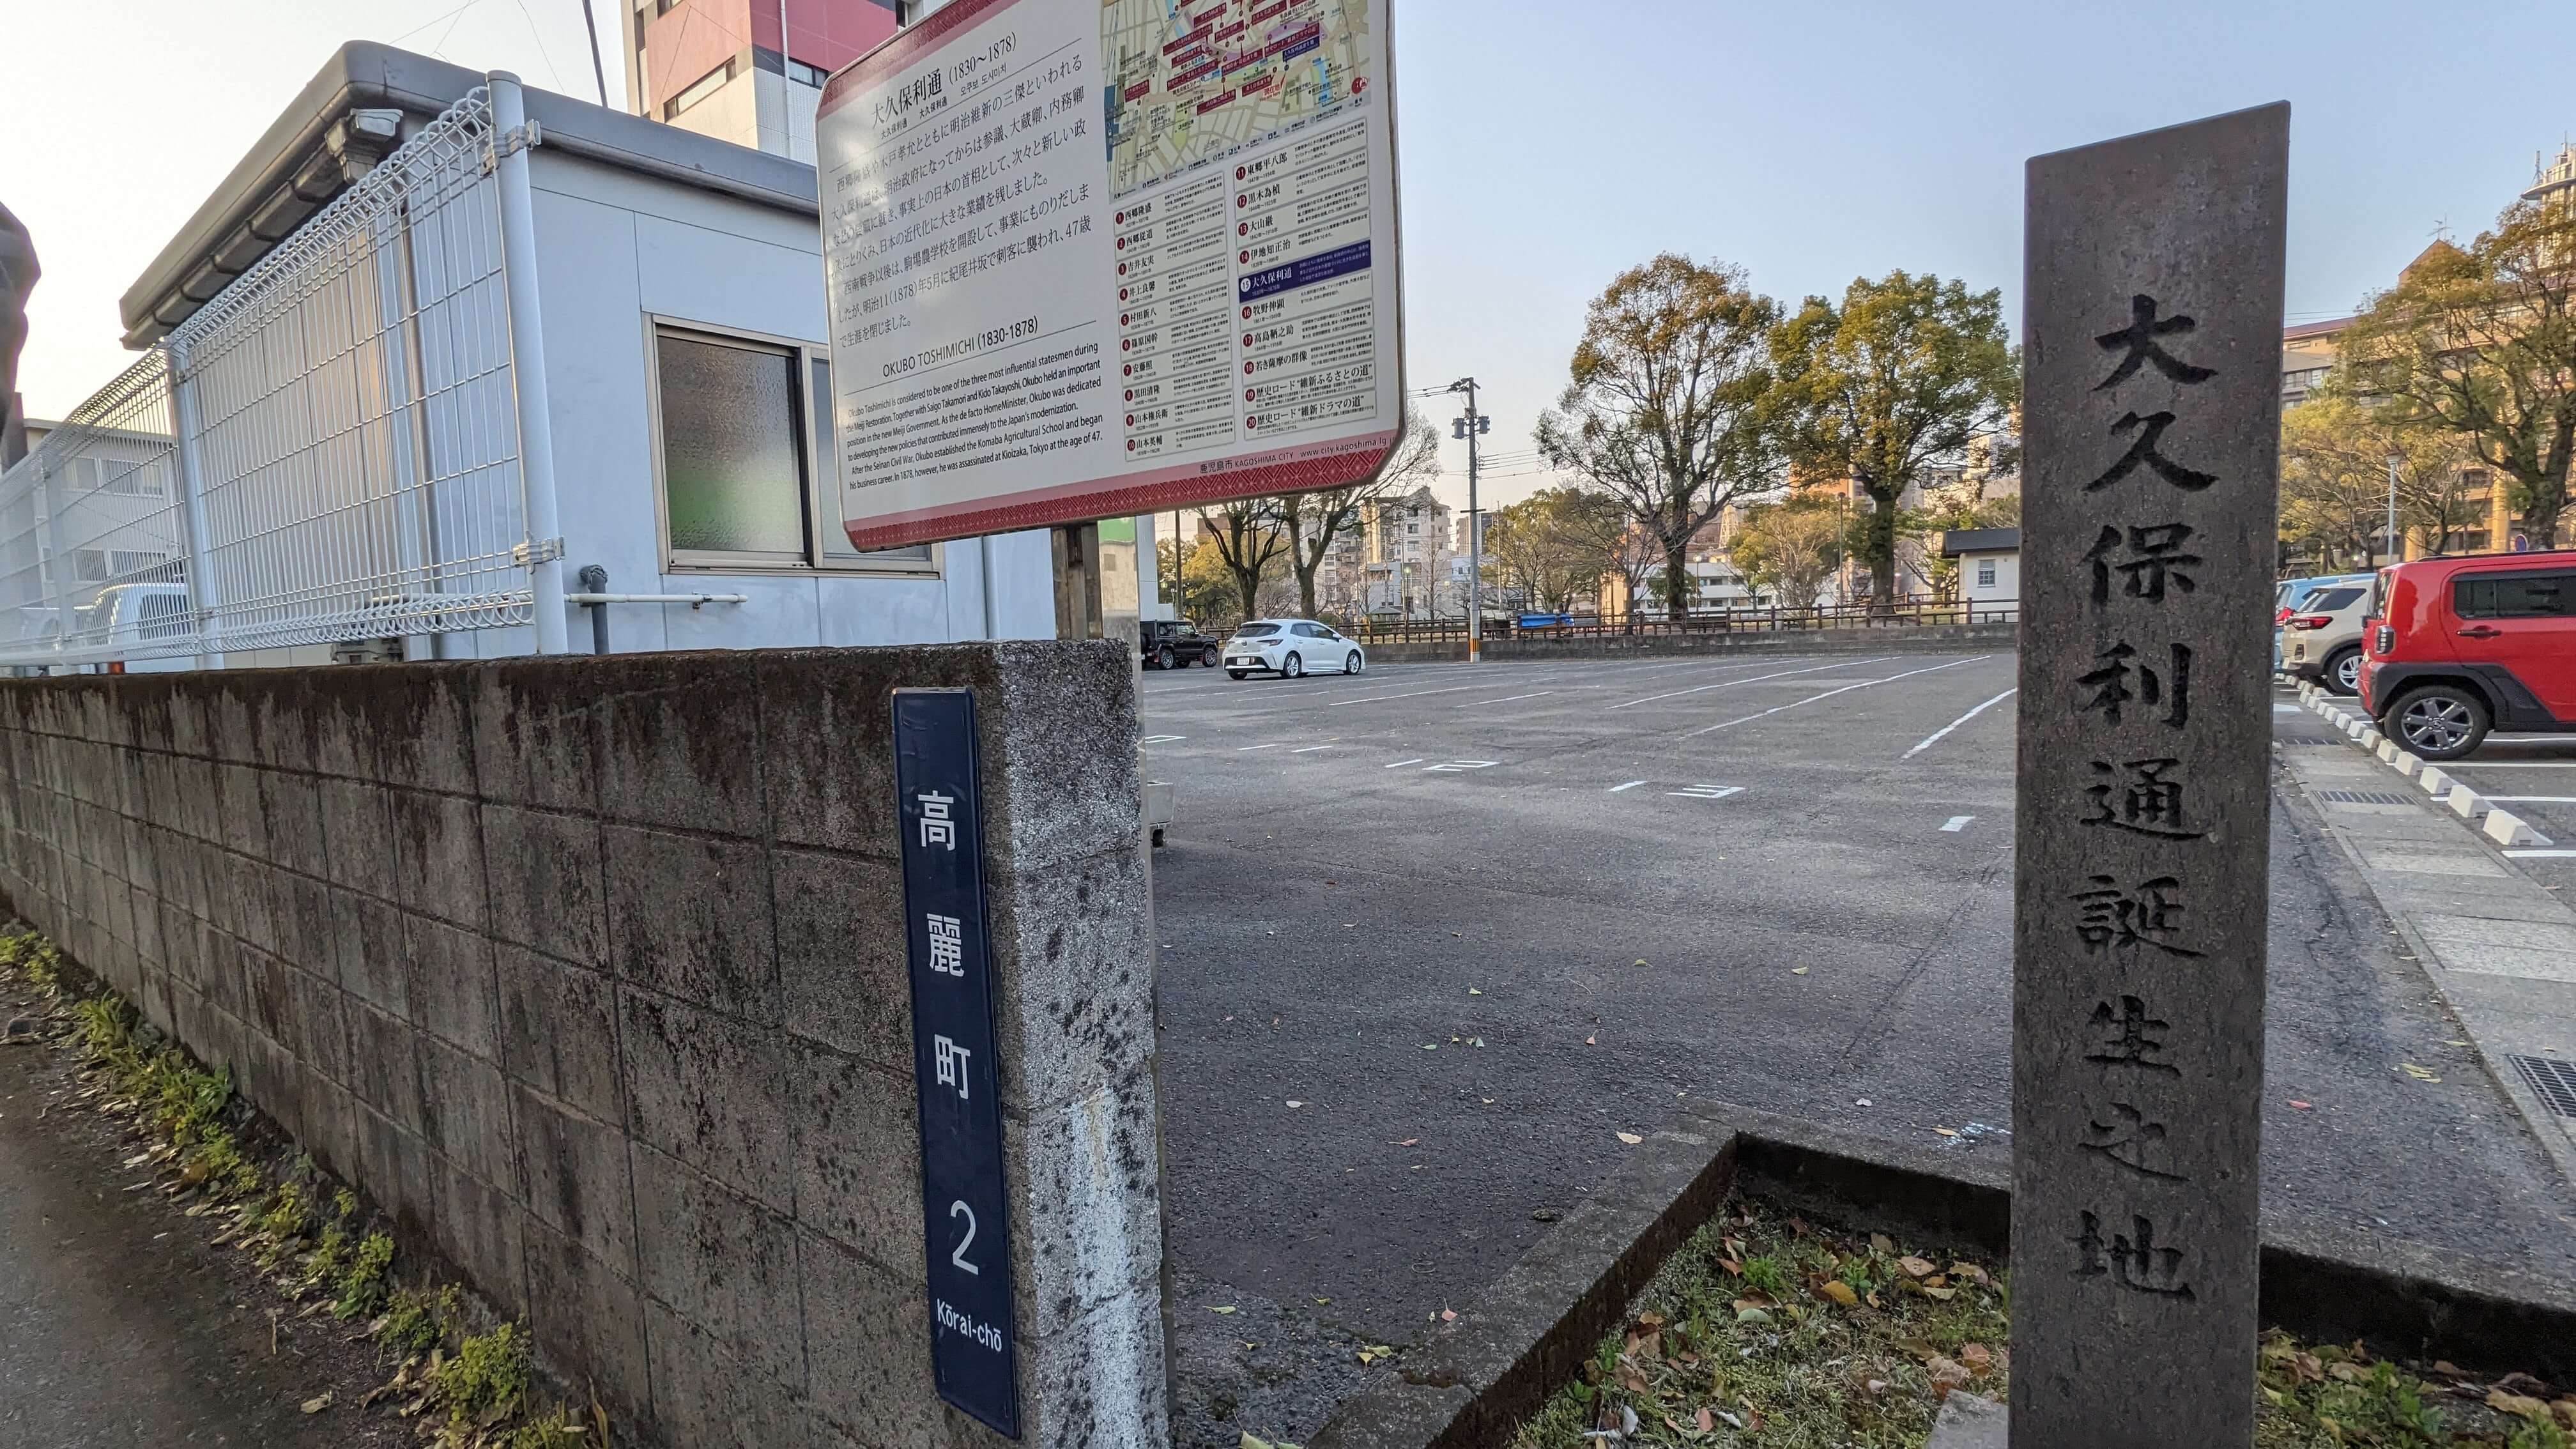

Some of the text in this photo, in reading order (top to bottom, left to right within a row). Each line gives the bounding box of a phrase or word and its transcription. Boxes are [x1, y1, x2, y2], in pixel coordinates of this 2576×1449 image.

[872, 68, 942, 129] 大久保利通
[919, 95, 947, 119] 大久保利通
[1238, 151, 1287, 178] 11 東郷平八郎
[1125, 202, 1151, 220] 西郷隆盛
[1239, 197, 1245, 206] 12
[1126, 228, 1153, 247] 西郷従道
[1240, 225, 1246, 234] 13
[1241, 238, 1290, 261] 14 伊地知正治
[1128, 254, 1154, 272] 吉井友実
[1242, 266, 1291, 289] 15 大久保利通
[1130, 306, 1156, 323] 村田新八
[839, 310, 911, 349] で生涯を閉じました。
[1245, 336, 1251, 344] 17
[883, 316, 1038, 377] OKUBO TOSHIMICHI (1830-1878)
[891, 396, 896, 405] is
[896, 388, 925, 403] considered
[926, 387, 932, 395] to
[933, 384, 940, 394] be
[941, 383, 952, 392] one
[953, 379, 959, 388] of
[960, 376, 970, 387] the
[971, 371, 987, 383] three
[988, 367, 1004, 379] most
[1004, 357, 1037, 374] influential
[1038, 348, 1073, 365] statesmen
[1074, 341, 1098, 358] during
[1255, 350, 1307, 371] 若き薩摩の群像
[893, 407, 914, 422] Together
[915, 404, 926, 415] with
[927, 400, 941, 414] Saigo
[942, 394, 966, 408] Takamori
[967, 390, 977, 401] and
[978, 387, 991, 399] Kido
[1022, 374, 1042, 387] Okubo
[1043, 370, 1057, 382] held
[1058, 370, 1066, 378] an
[1068, 358, 1101, 378] important
[1134, 384, 1160, 399] 黒田清隆
[847, 434, 866, 449] position
[866, 433, 871, 442] in
[872, 431, 880, 441] the
[881, 430, 892, 438] new
[941, 413, 948, 424] As
[949, 411, 958, 422] the
[959, 409, 967, 420] de
[967, 405, 983, 417] facto
[1029, 388, 1050, 402] Okubo
[1052, 387, 1065, 397] was
[1066, 375, 1101, 394] dedicated
[848, 452, 852, 461] to
[853, 446, 878, 463] developing
[898, 438, 916, 452] policies
[917, 435, 928, 445] that
[928, 427, 958, 442] contributed
[960, 420, 989, 438] immensely
[990, 419, 996, 429] to
[997, 417, 1007, 427] the
[852, 464, 863, 475] After
[864, 463, 872, 472] the
[873, 459, 890, 470] Seinan
[891, 456, 901, 467] Civil
[915, 449, 933, 461] Okubo
[934, 441, 966, 457] established
[967, 440, 976, 450] the
[977, 434, 1002, 448] Komaba
[1003, 425, 1041, 445] Agricultural
[1041, 420, 1064, 434] School
[1065, 417, 1079, 429] and
[1080, 411, 1103, 429] began
[857, 476, 877, 489] business
[894, 471, 900, 481] In
[939, 462, 946, 472] he
[947, 462, 958, 470] was
[958, 452, 993, 468] assassinated
[995, 450, 1000, 461] at
[1029, 441, 1048, 457] Tokyo
[1049, 439, 1056, 450] at
[1057, 436, 1068, 448] the
[1070, 436, 1082, 448] age
[1083, 432, 1091, 443] of
[1200, 460, 1232, 473] 鹿児島市
[1235, 455, 1276, 468] KAGOSHIMA
[1278, 452, 1294, 461] CITY
[2066, 294, 2219, 1301] 大久保利通誕生之地
[917, 790, 979, 1275] 高麗町 2
[937, 1298, 1002, 1353] Kōrai-chō
